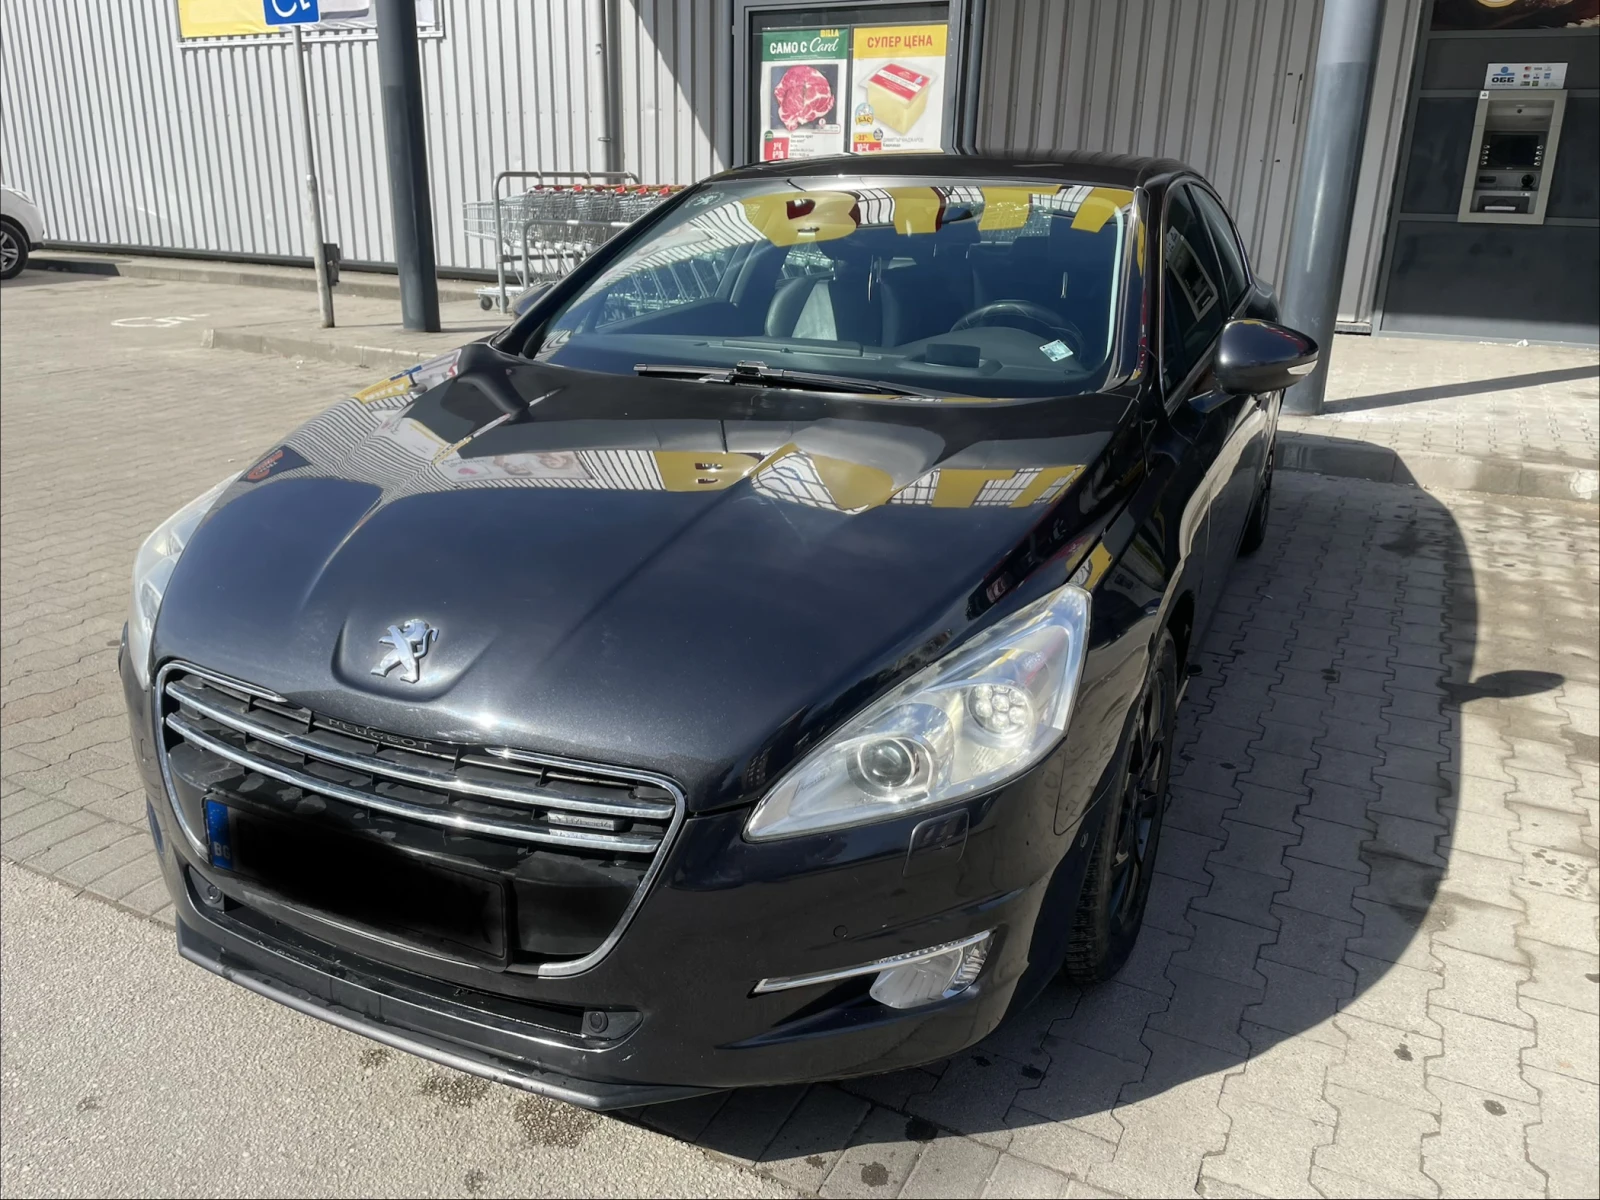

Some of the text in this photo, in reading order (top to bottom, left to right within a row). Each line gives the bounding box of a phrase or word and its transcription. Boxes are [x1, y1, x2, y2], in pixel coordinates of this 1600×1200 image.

[820, 29, 840, 37] BILLA
[867, 34, 933, 49] СУПЕР ЦЕНА
[769, 37, 840, 54] САМО С Card
[329, 718, 432, 750] PEUGEOT
[213, 841, 231, 860] BG
